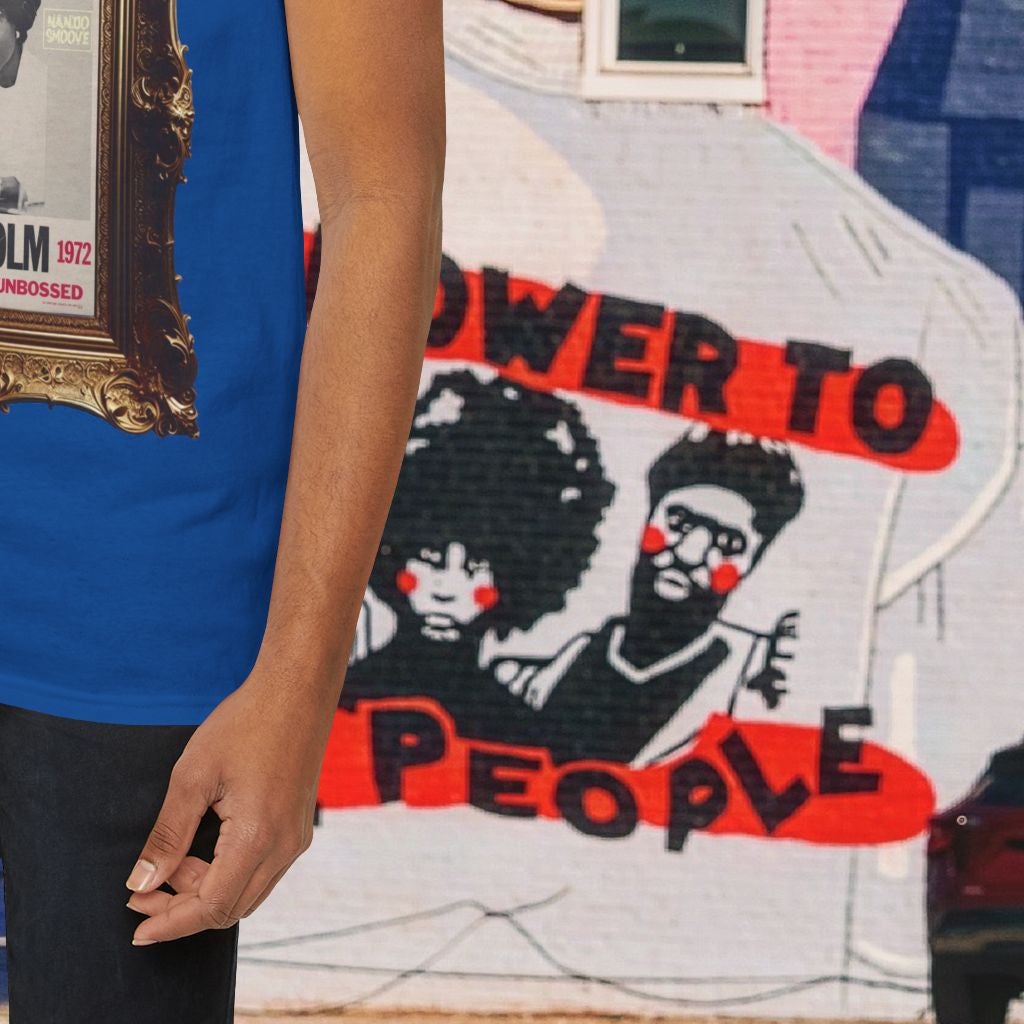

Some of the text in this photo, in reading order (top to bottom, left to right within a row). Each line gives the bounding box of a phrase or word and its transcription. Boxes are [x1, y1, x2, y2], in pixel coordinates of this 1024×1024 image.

[46, 28, 89, 45] SMOOVE
[56, 239, 92, 266] 1972
[784, 339, 935, 456] TO
[368, 705, 883, 854] PEOPLE
